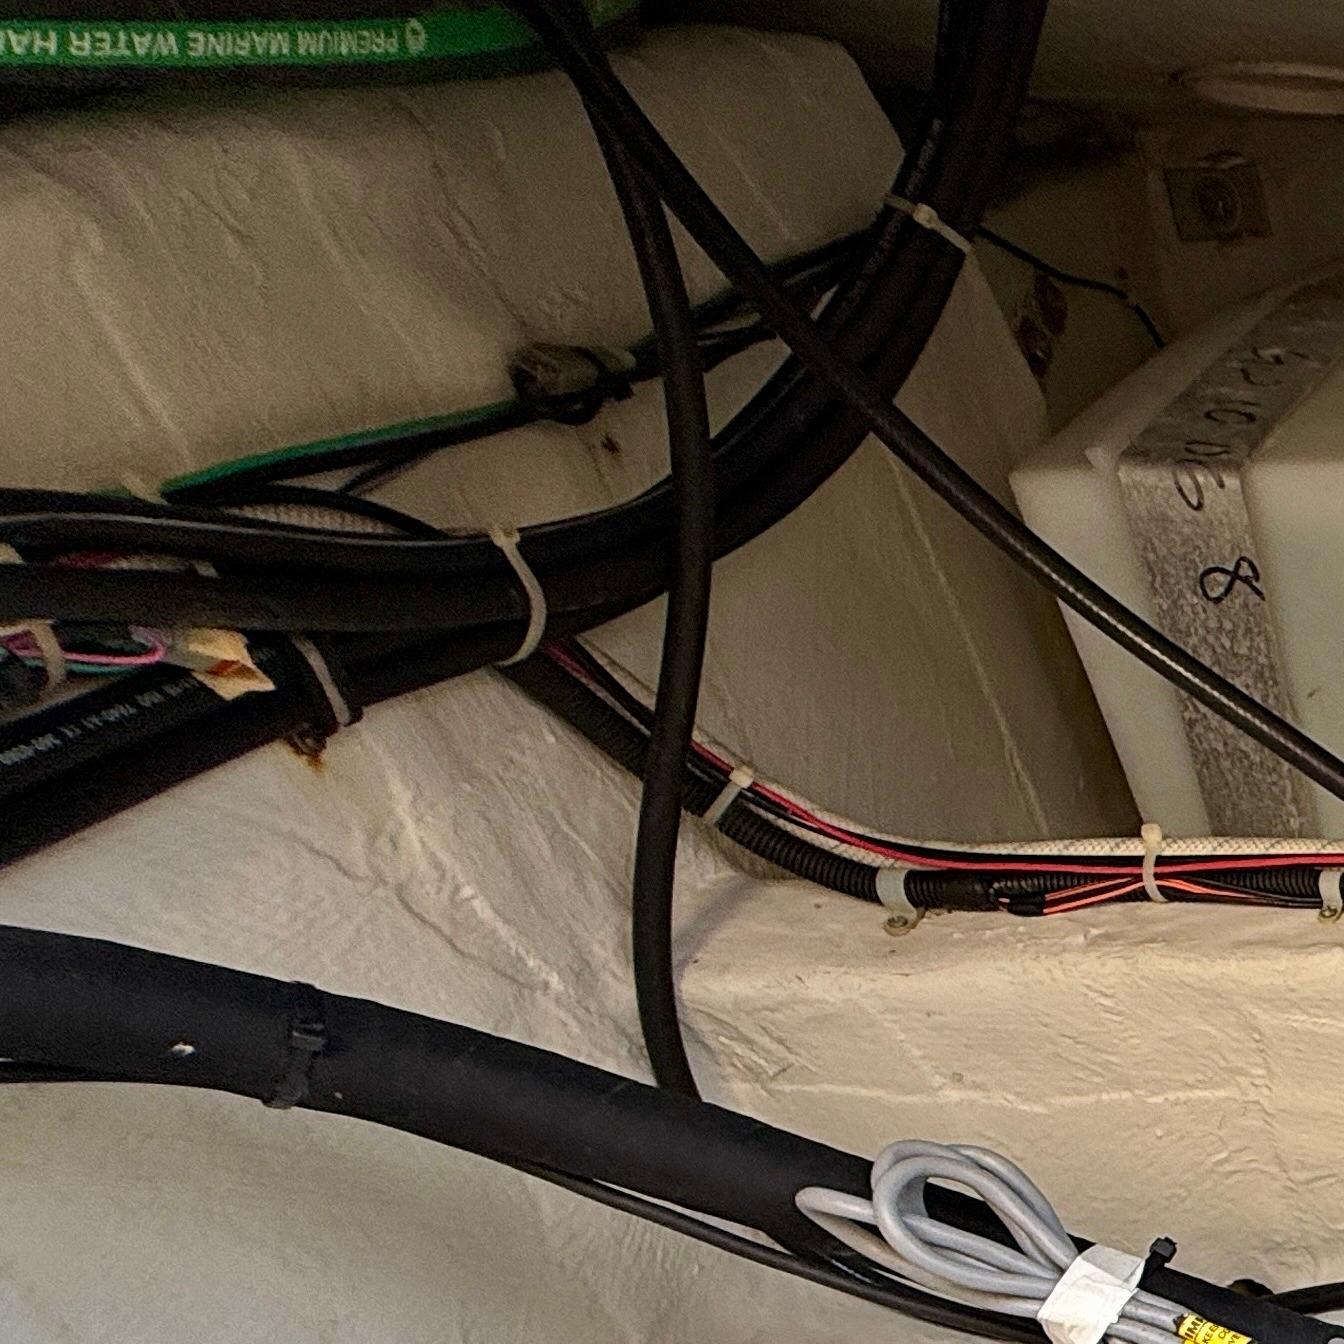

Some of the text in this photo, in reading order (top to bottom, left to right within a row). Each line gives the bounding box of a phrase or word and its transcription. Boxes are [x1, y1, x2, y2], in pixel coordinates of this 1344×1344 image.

[0, 29, 399, 57] PREMIUM MARINE WATER HA
